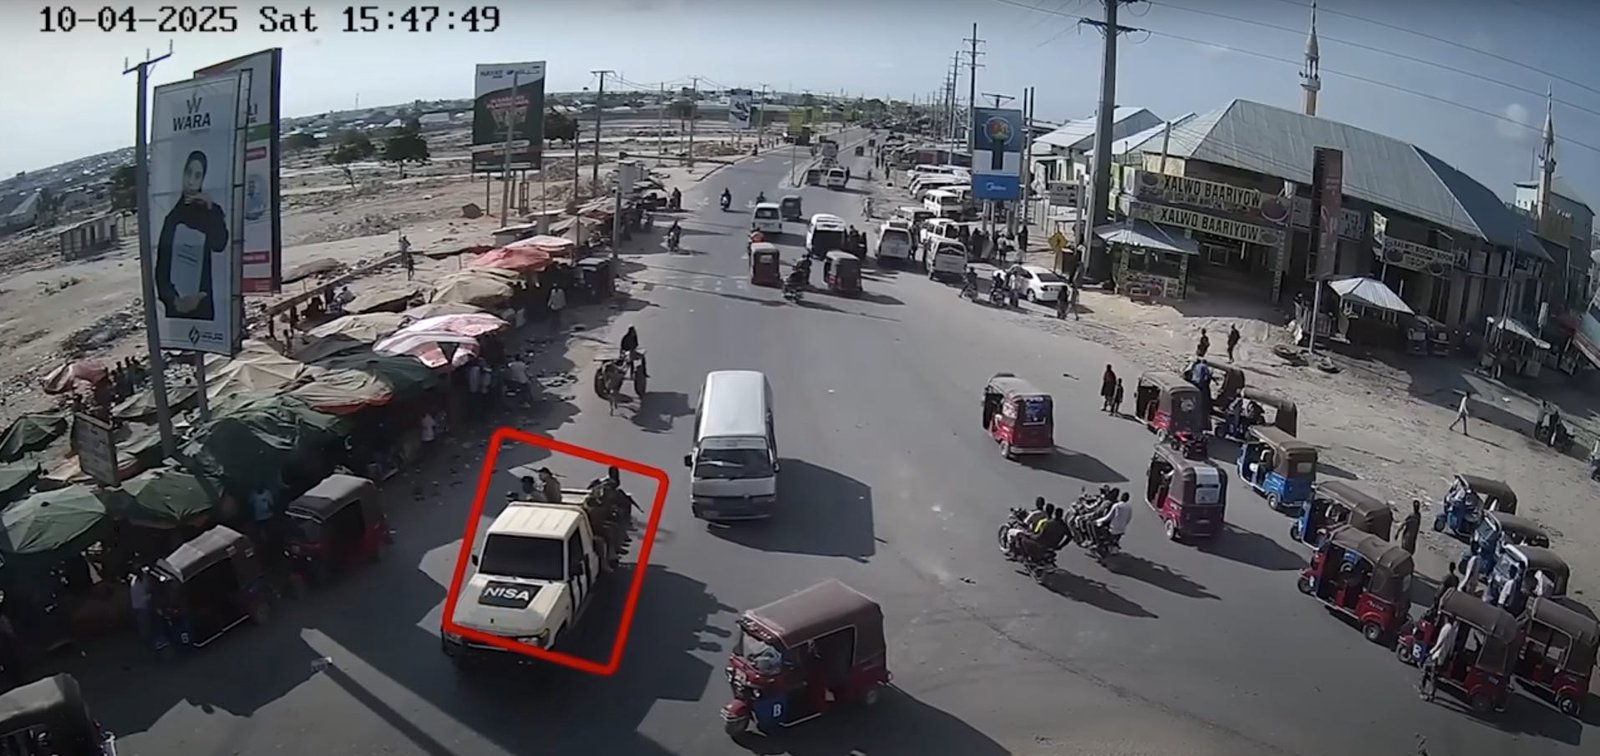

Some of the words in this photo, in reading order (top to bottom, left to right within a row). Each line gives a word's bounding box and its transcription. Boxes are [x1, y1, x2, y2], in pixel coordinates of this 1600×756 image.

[173, 112, 211, 132] WARA
[1163, 175, 1201, 196] XALWO
[1204, 182, 1262, 208] BAARIYOW
[1160, 207, 1198, 227] XALWO
[1201, 217, 1259, 241] BAARIYOW
[484, 586, 530, 602] NISA
[1412, 643, 1422, 659] B
[773, 703, 782, 718] B
